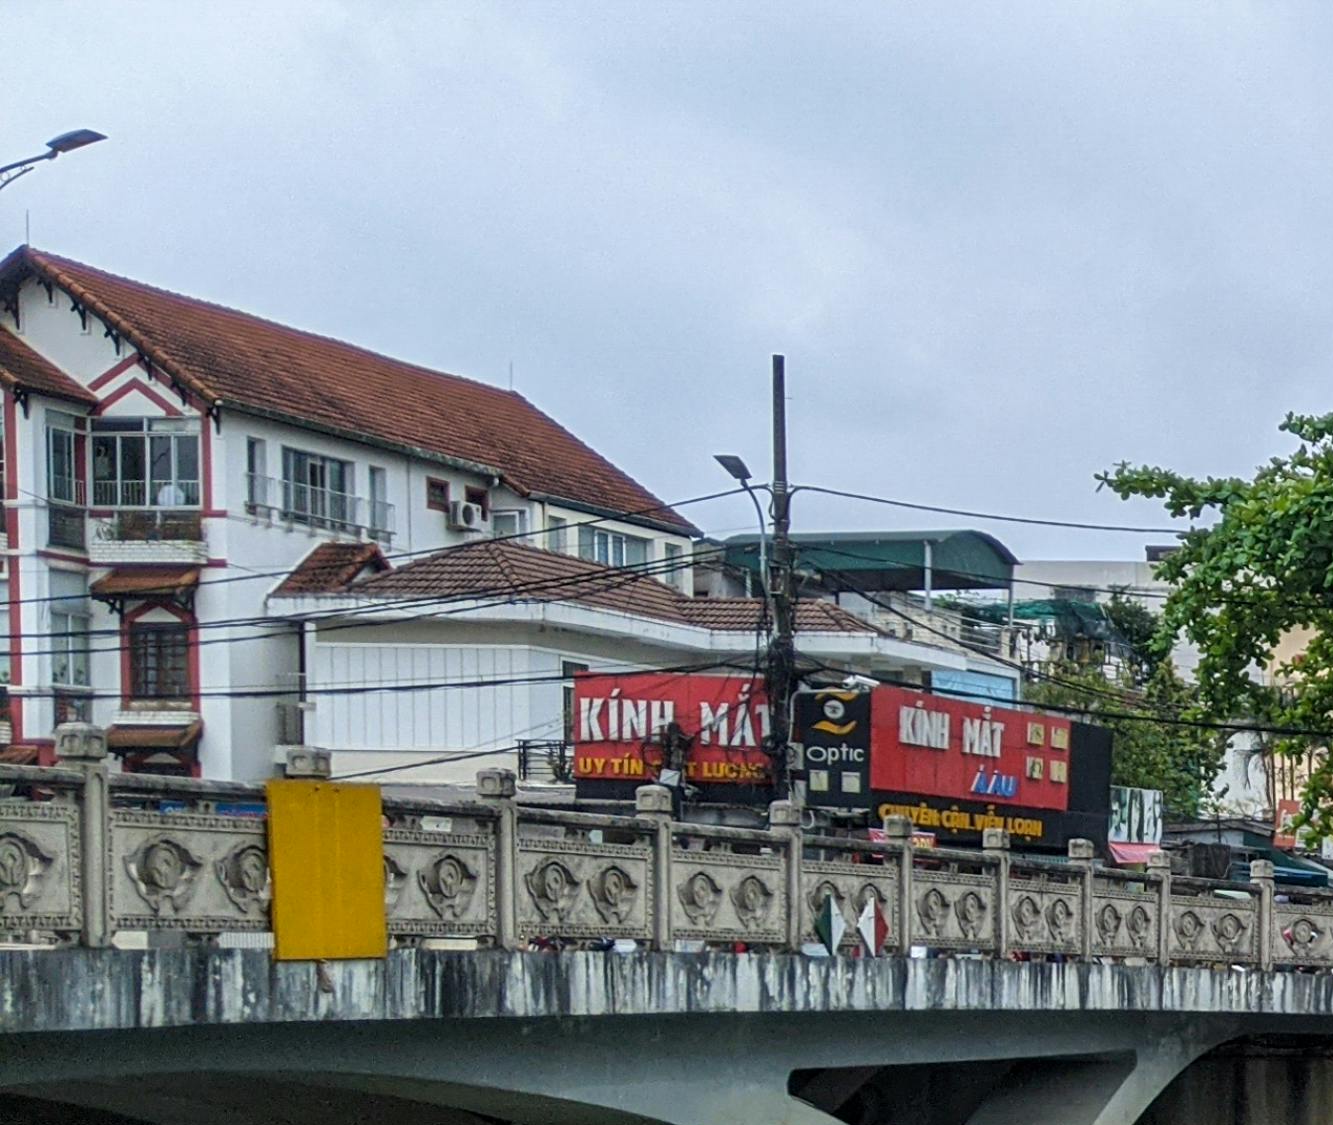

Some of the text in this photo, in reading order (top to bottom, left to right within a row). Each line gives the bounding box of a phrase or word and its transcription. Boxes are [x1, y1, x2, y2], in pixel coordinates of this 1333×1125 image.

[579, 688, 674, 743] KÍNH
[899, 701, 1005, 758] KÍNH MẮT
[578, 757, 606, 775] UY
[611, 753, 644, 775] TÍN
[806, 742, 865, 766] Optic
